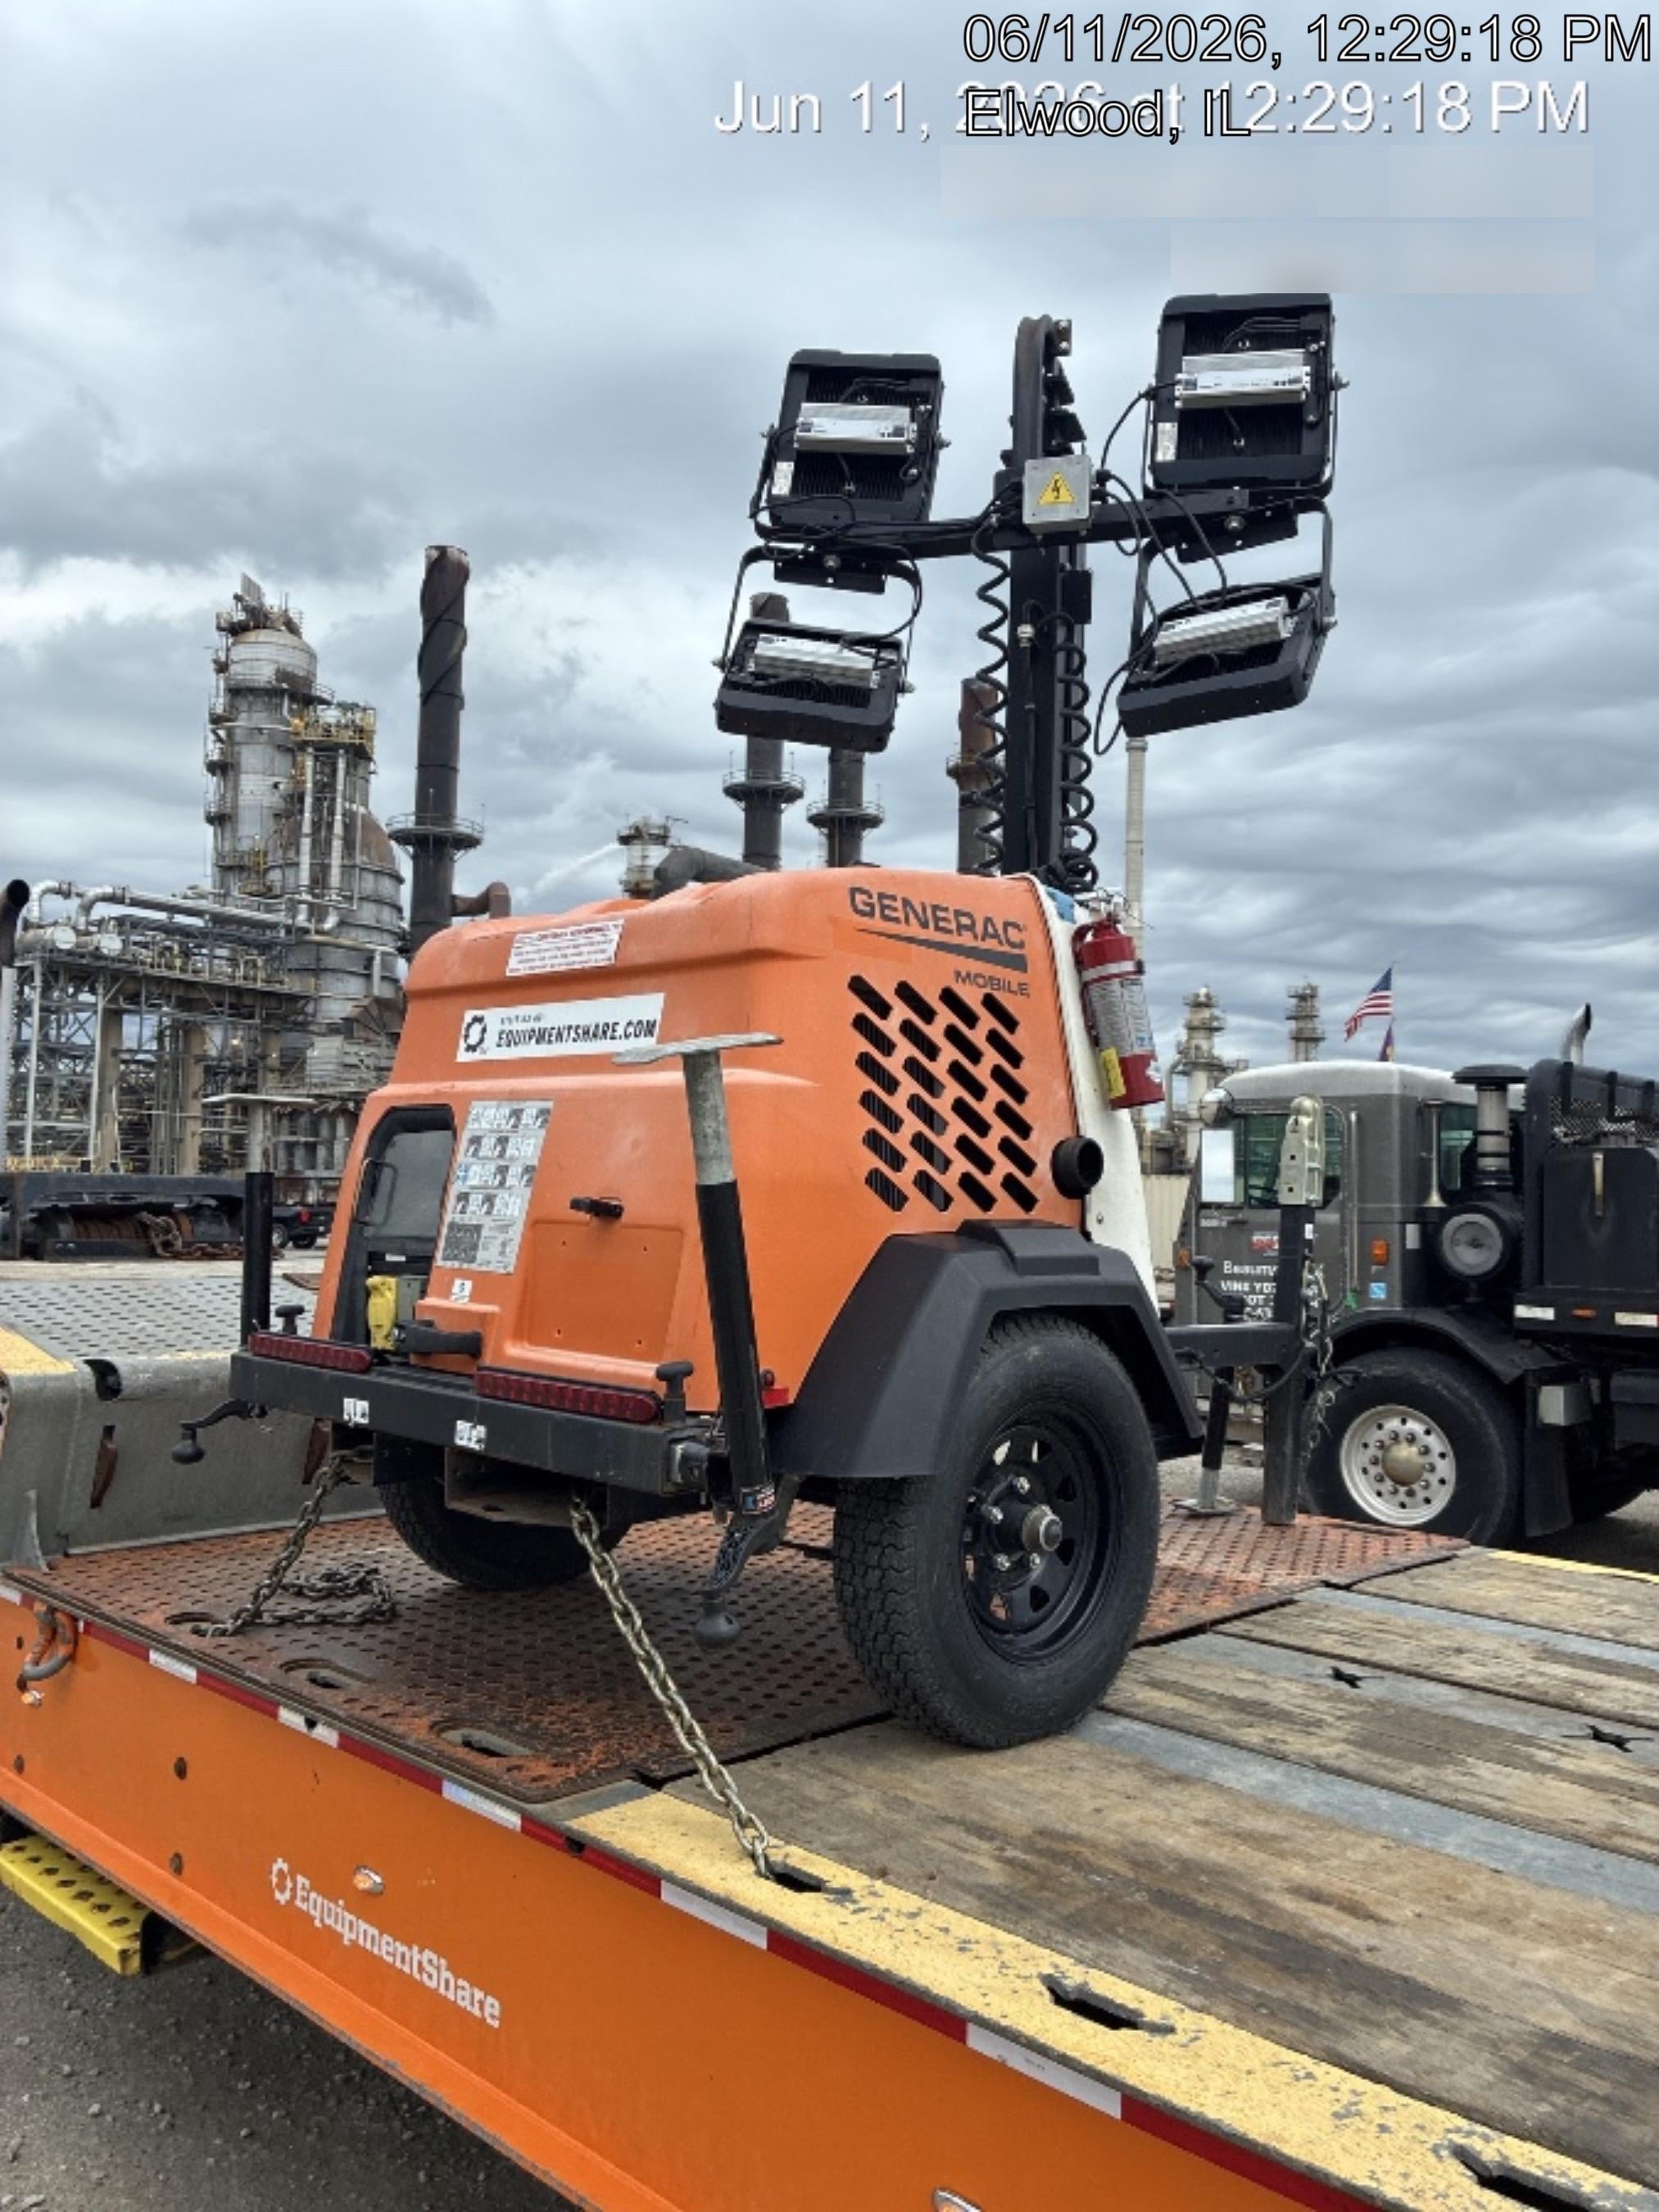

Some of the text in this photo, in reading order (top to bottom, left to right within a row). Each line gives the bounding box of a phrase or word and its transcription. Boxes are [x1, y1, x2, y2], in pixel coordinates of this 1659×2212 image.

[849, 886, 1026, 950] GENERAC
[953, 969, 1030, 998] MOBILE
[496, 1018, 657, 1049] EQUIPMENTSHARE.COM
[293, 1873, 501, 2029] EquipmentShare
